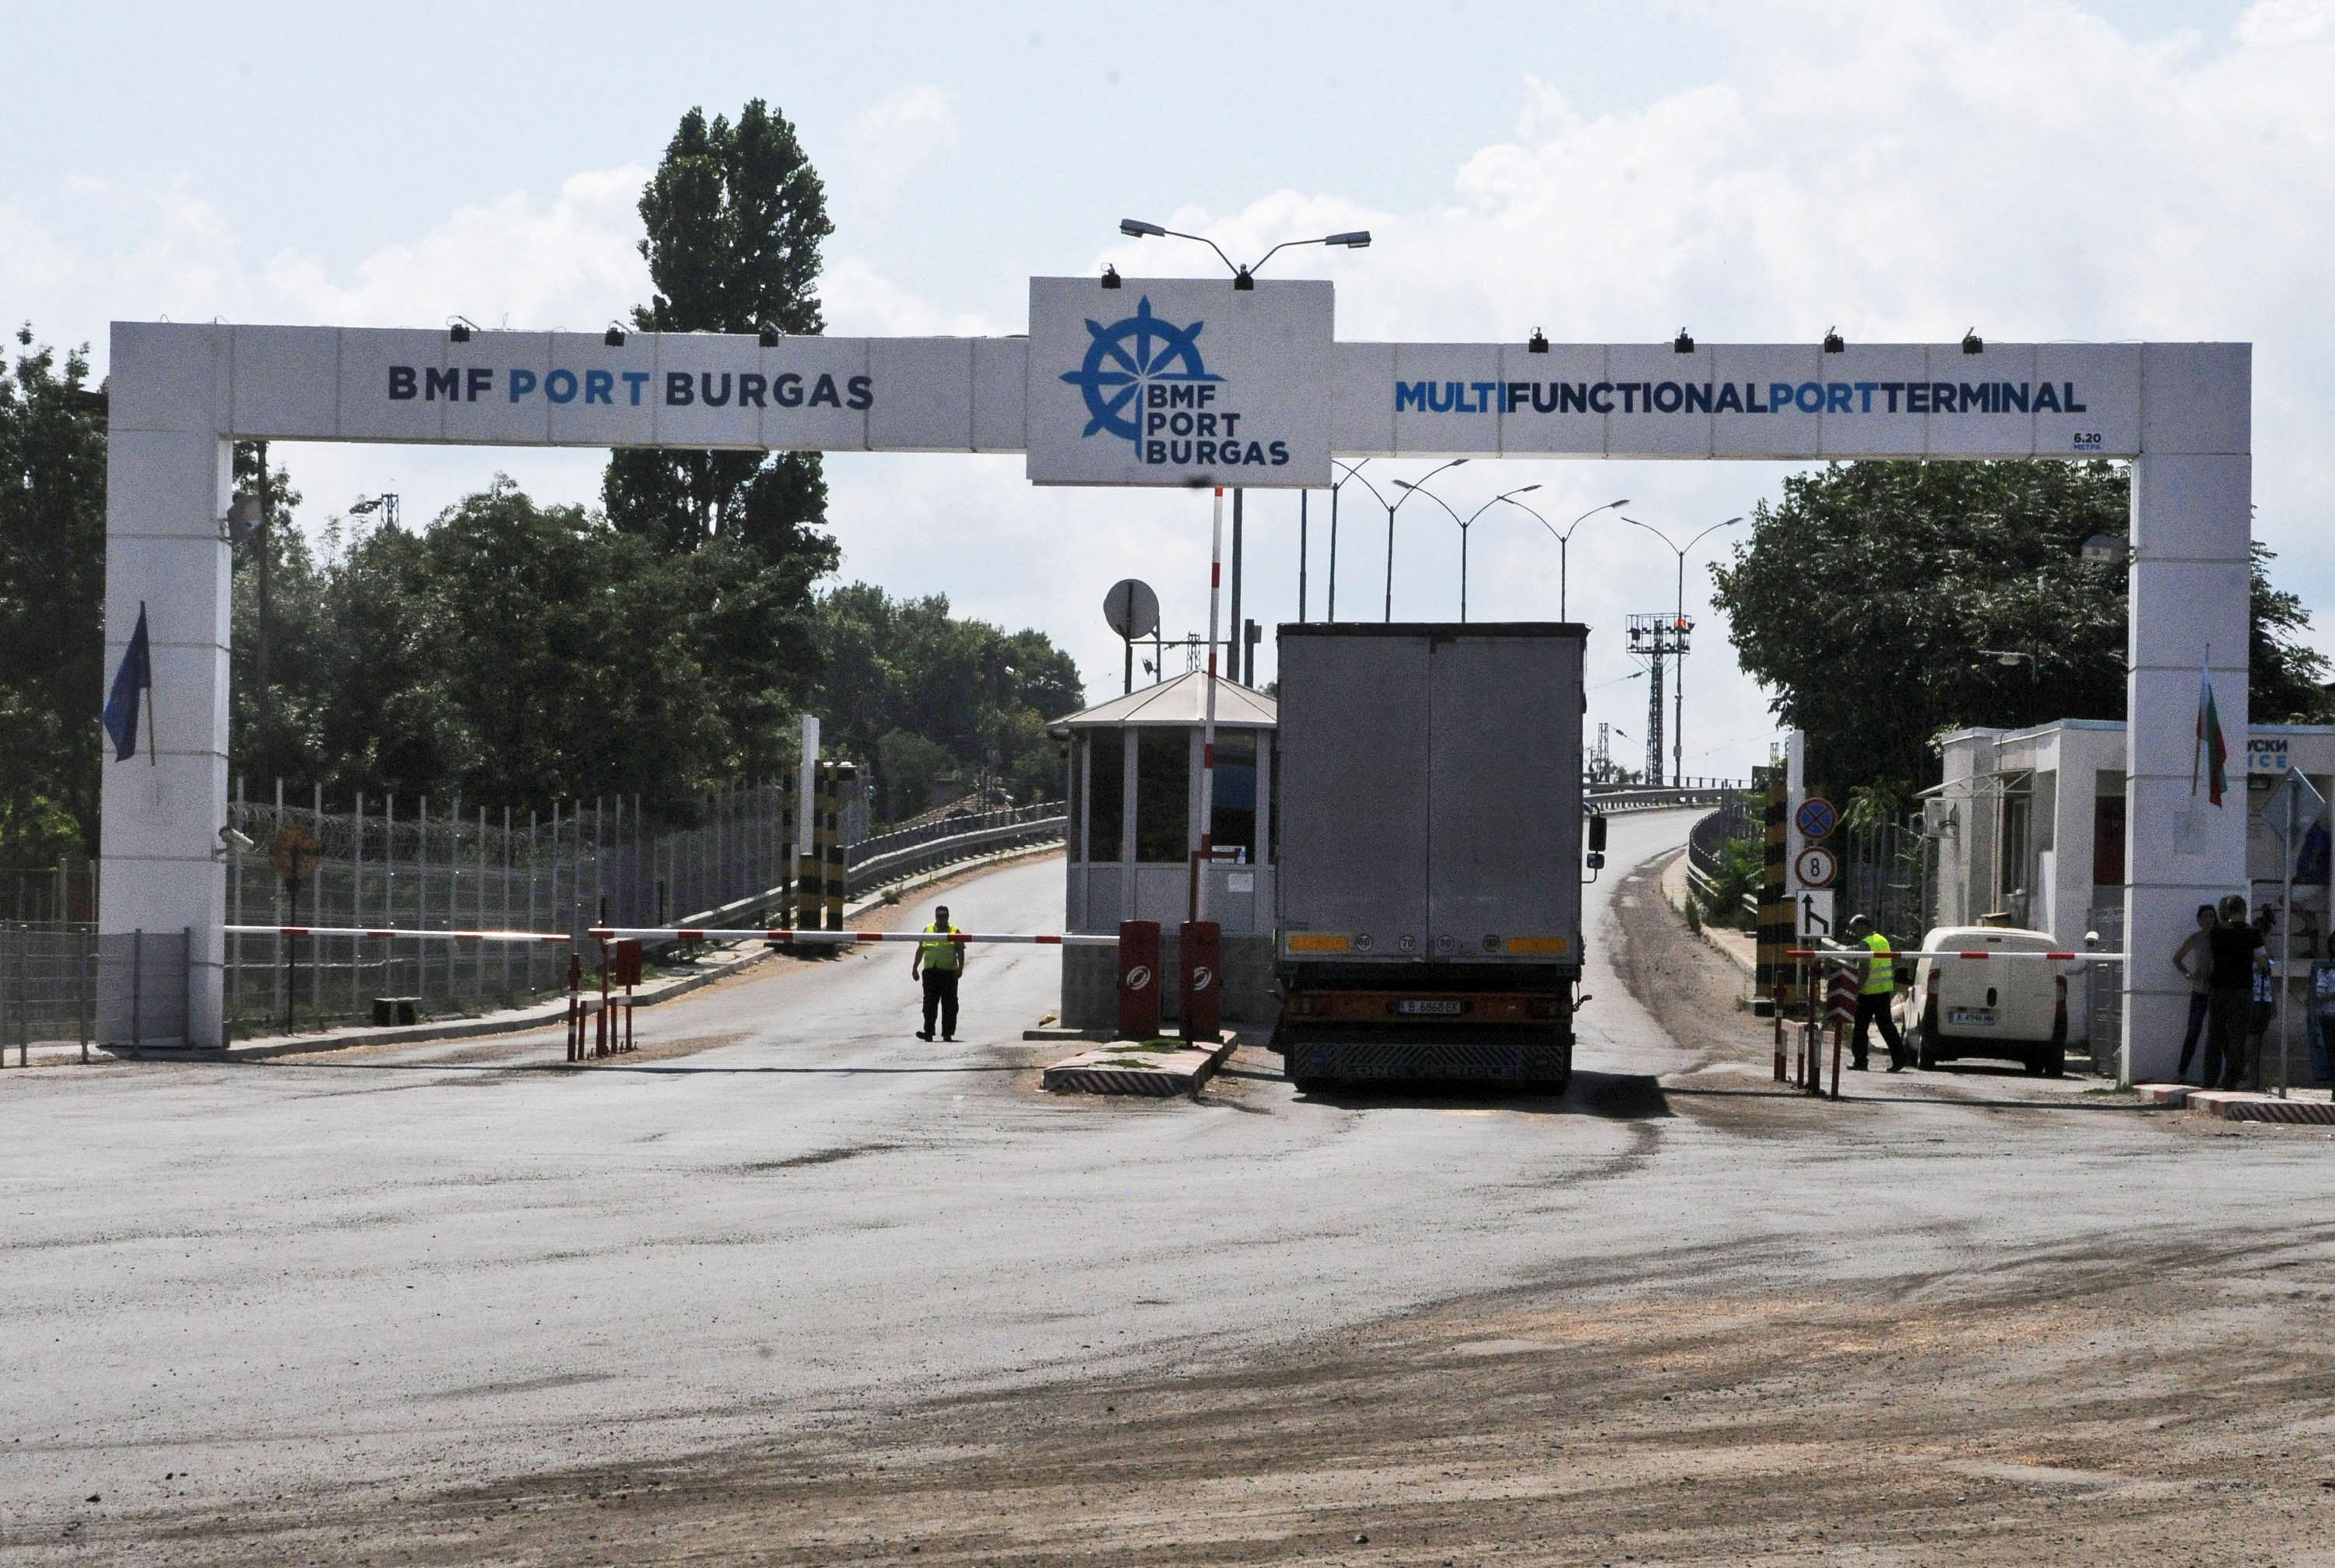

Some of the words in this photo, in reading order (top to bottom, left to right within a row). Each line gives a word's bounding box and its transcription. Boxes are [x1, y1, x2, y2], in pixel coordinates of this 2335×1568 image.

[388, 366, 493, 402] BMF
[510, 369, 650, 405] PORT
[666, 372, 874, 410] BURGAS
[1147, 384, 1216, 409] BMF
[1147, 412, 1241, 437] PORT
[2073, 433, 2101, 443] 6.20
[1146, 440, 1290, 466] BURGAS
[1810, 858, 1820, 876] 8
[1403, 938, 1413, 948] 70
[1440, 938, 1452, 948] 80
